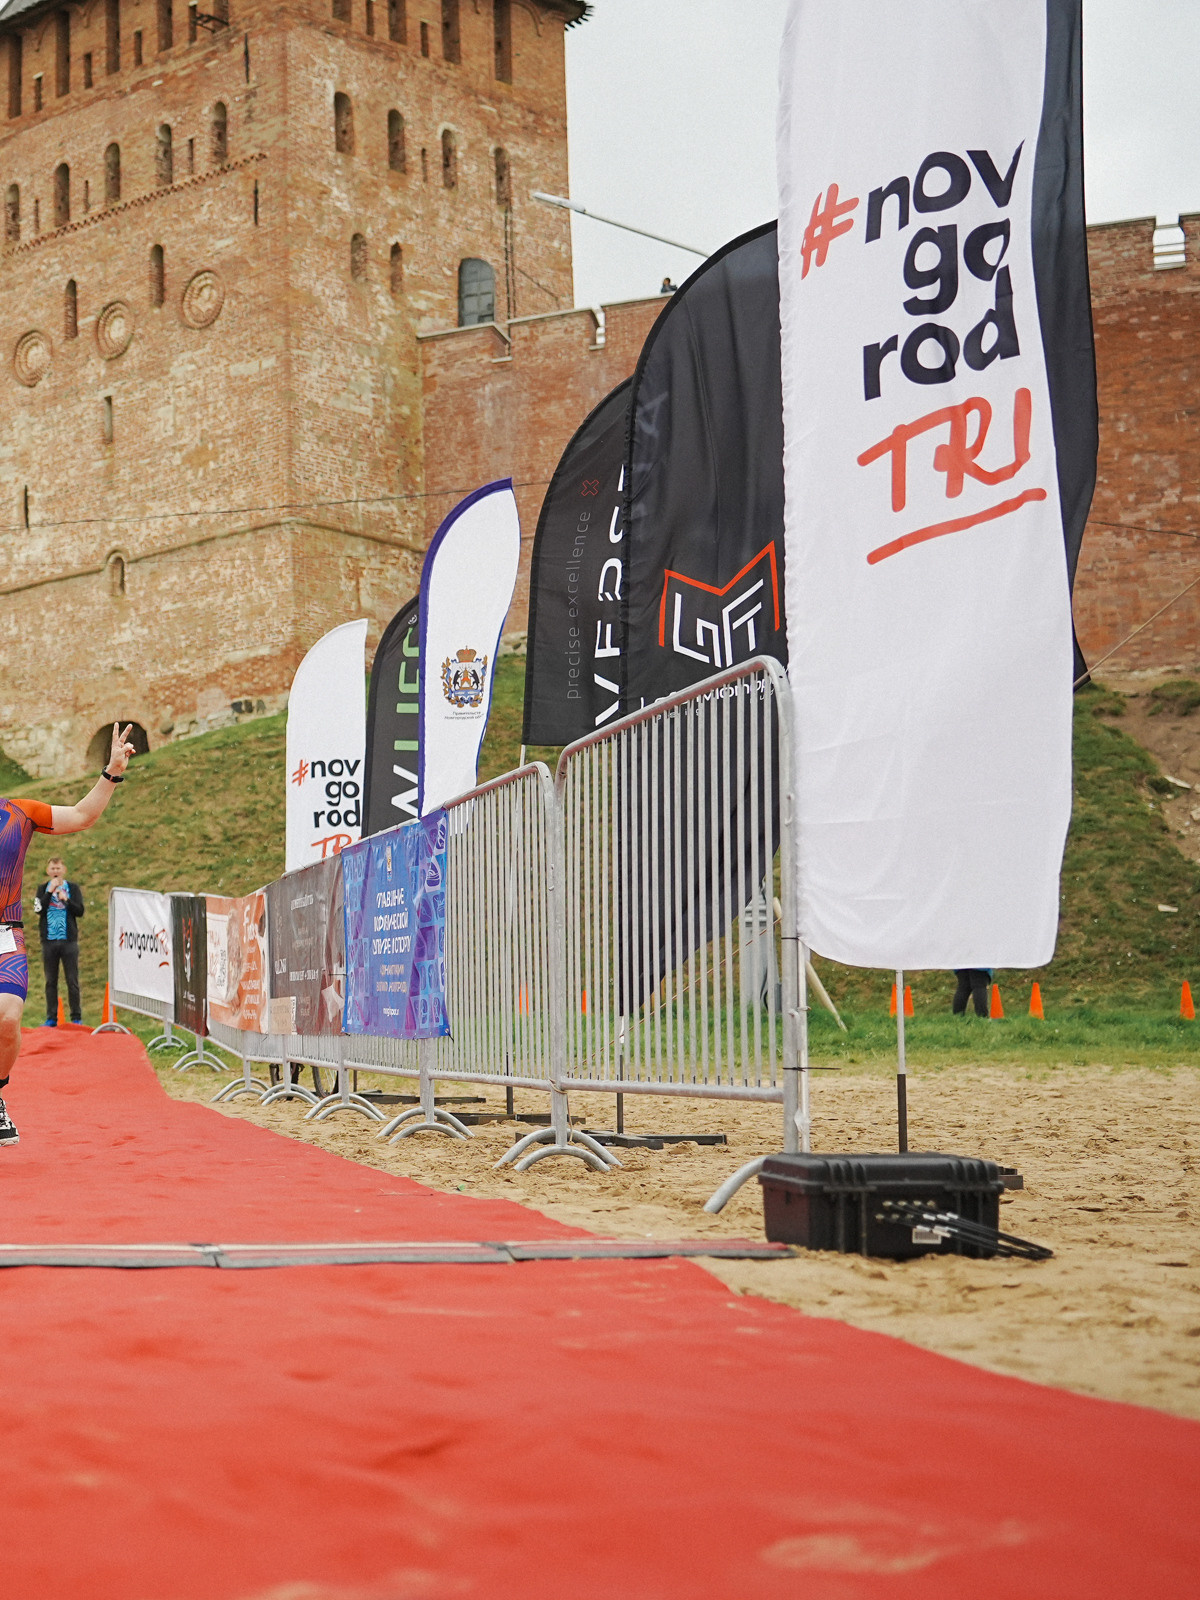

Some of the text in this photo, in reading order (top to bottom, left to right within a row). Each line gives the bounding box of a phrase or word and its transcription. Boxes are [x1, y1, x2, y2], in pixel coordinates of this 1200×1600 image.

[801, 139, 1025, 281] #nov
[863, 265, 1020, 401] rod
[857, 387, 1031, 512] TRI
[565, 511, 591, 700] precise excellence
[292, 758, 361, 787] #nov
[313, 800, 361, 829] rod
[325, 781, 360, 807] go
